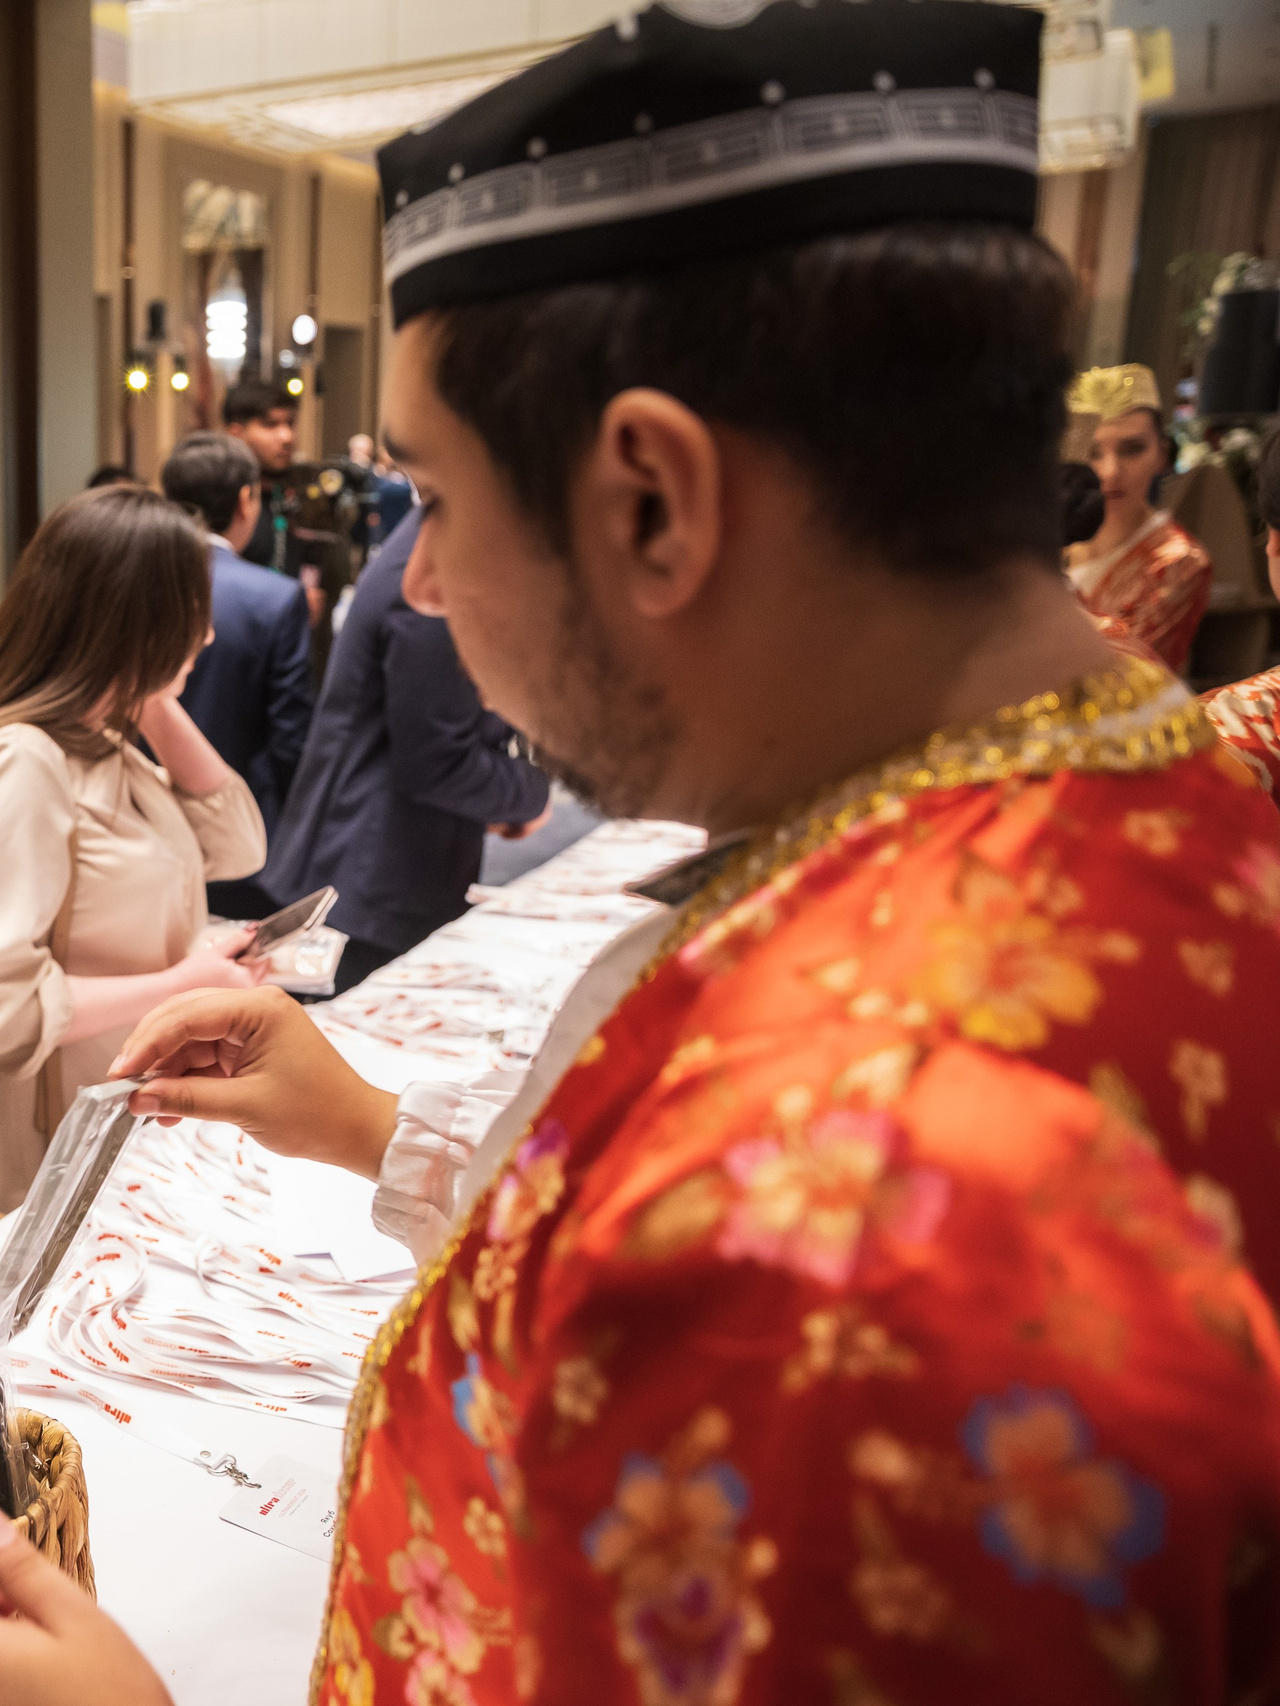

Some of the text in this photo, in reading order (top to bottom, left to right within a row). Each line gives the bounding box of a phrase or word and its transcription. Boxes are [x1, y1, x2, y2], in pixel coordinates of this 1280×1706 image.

[277, 1291, 303, 1309] ultra
[107, 1340, 130, 1363] ultra
[104, 1402, 132, 1424] ultra
[254, 1401, 288, 1412] ultra
[259, 1497, 280, 1516] ultra
